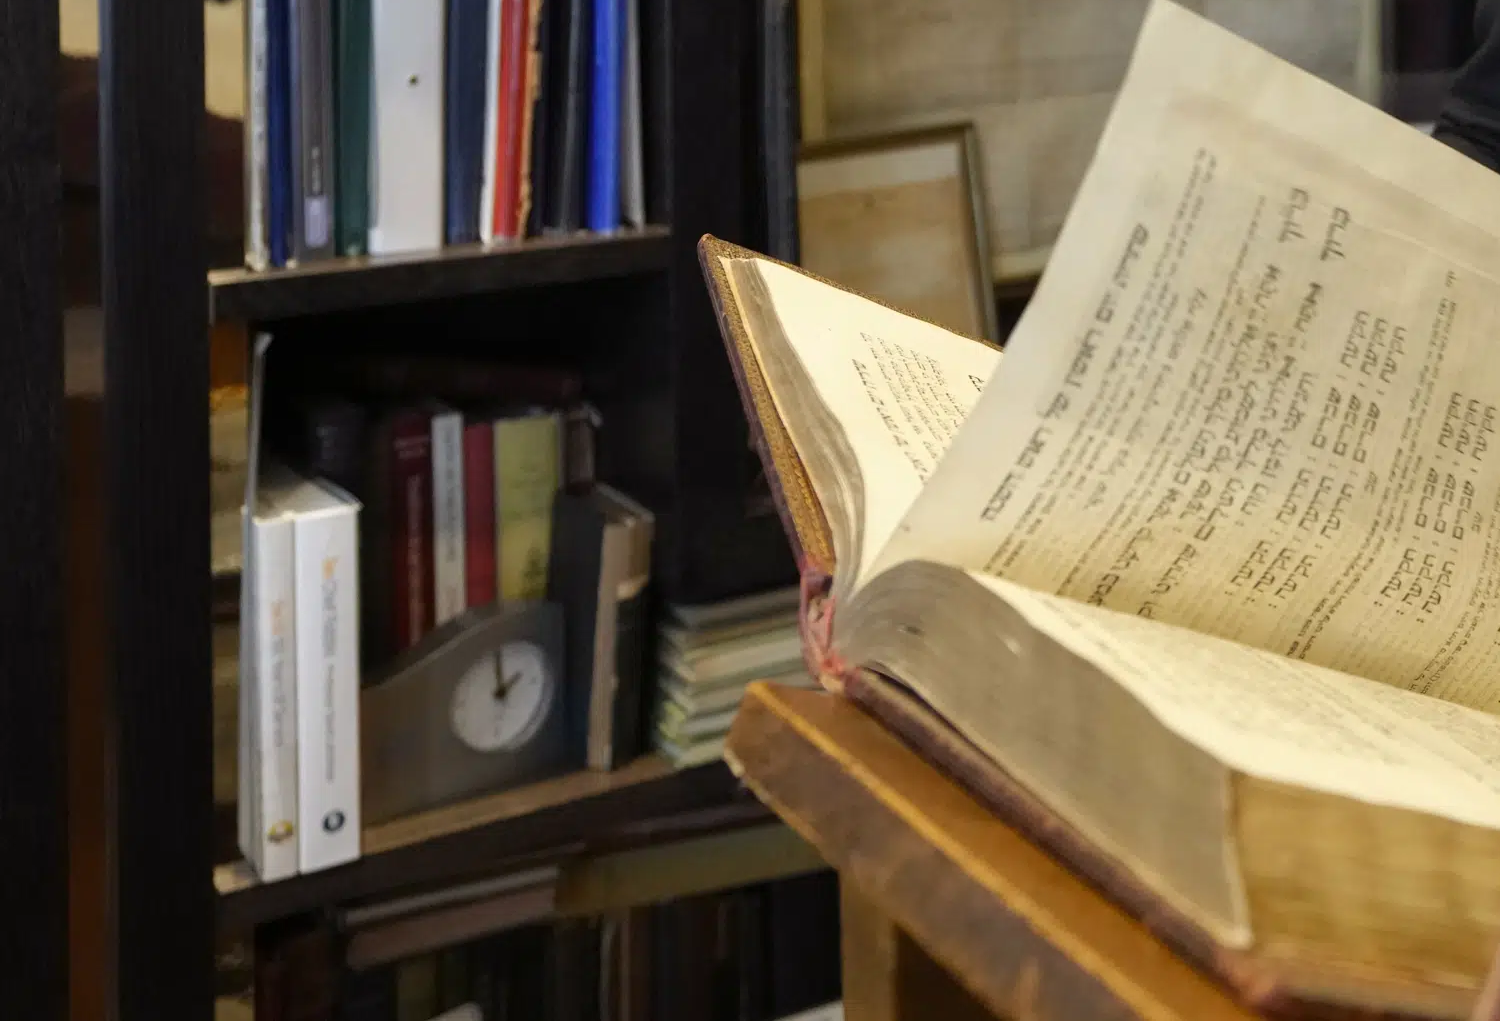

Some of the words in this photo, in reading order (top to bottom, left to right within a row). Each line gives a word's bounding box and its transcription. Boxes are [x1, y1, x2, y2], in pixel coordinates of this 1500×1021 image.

[1277, 187, 1310, 243] ברוך
[1319, 206, 1351, 262] ברוך
[1095, 293, 1114, 324] יום
[1254, 264, 1281, 309] אתה
[1294, 282, 1323, 332] אתה
[1064, 328, 1097, 388] ראשון
[1222, 323, 1259, 383] אלהינו
[1339, 310, 1370, 369] תקיעה
[1359, 317, 1388, 376] תקיעה
[1378, 326, 1407, 384] תקיעה
[1042, 392, 1070, 420] של
[1203, 387, 1233, 425] מלך
[1259, 354, 1297, 422] אלהינו
[1310, 386, 1342, 450] שברים
[1332, 394, 1362, 457] שברים
[1352, 401, 1381, 464] שברים
[1437, 391, 1463, 448] תקיעה
[1454, 399, 1480, 455] תקיעה
[1471, 406, 1497, 462] תקיעה
[1017, 427, 1046, 469] ראש
[1172, 428, 1216, 486] העולם
[1235, 428, 1269, 471] מלך
[1146, 487, 1180, 524] אשר
[1179, 478, 1212, 520] שופר
[1193, 477, 1245, 542] העולם
[1275, 468, 1313, 525] תרועה
[1297, 475, 1334, 532] תרועה
[1319, 483, 1354, 540] תרועה
[1413, 467, 1439, 529] שברים
[1432, 472, 1457, 534] שברים
[1451, 479, 1475, 541] שברים
[1230, 539, 1269, 587] תקיעה
[1252, 547, 1292, 593] תקיעה
[1274, 554, 1313, 600] תקיעה
[1379, 547, 1417, 598] תקיעה
[1400, 553, 1436, 606] תקיעה
[1421, 560, 1455, 614] תקיעה
